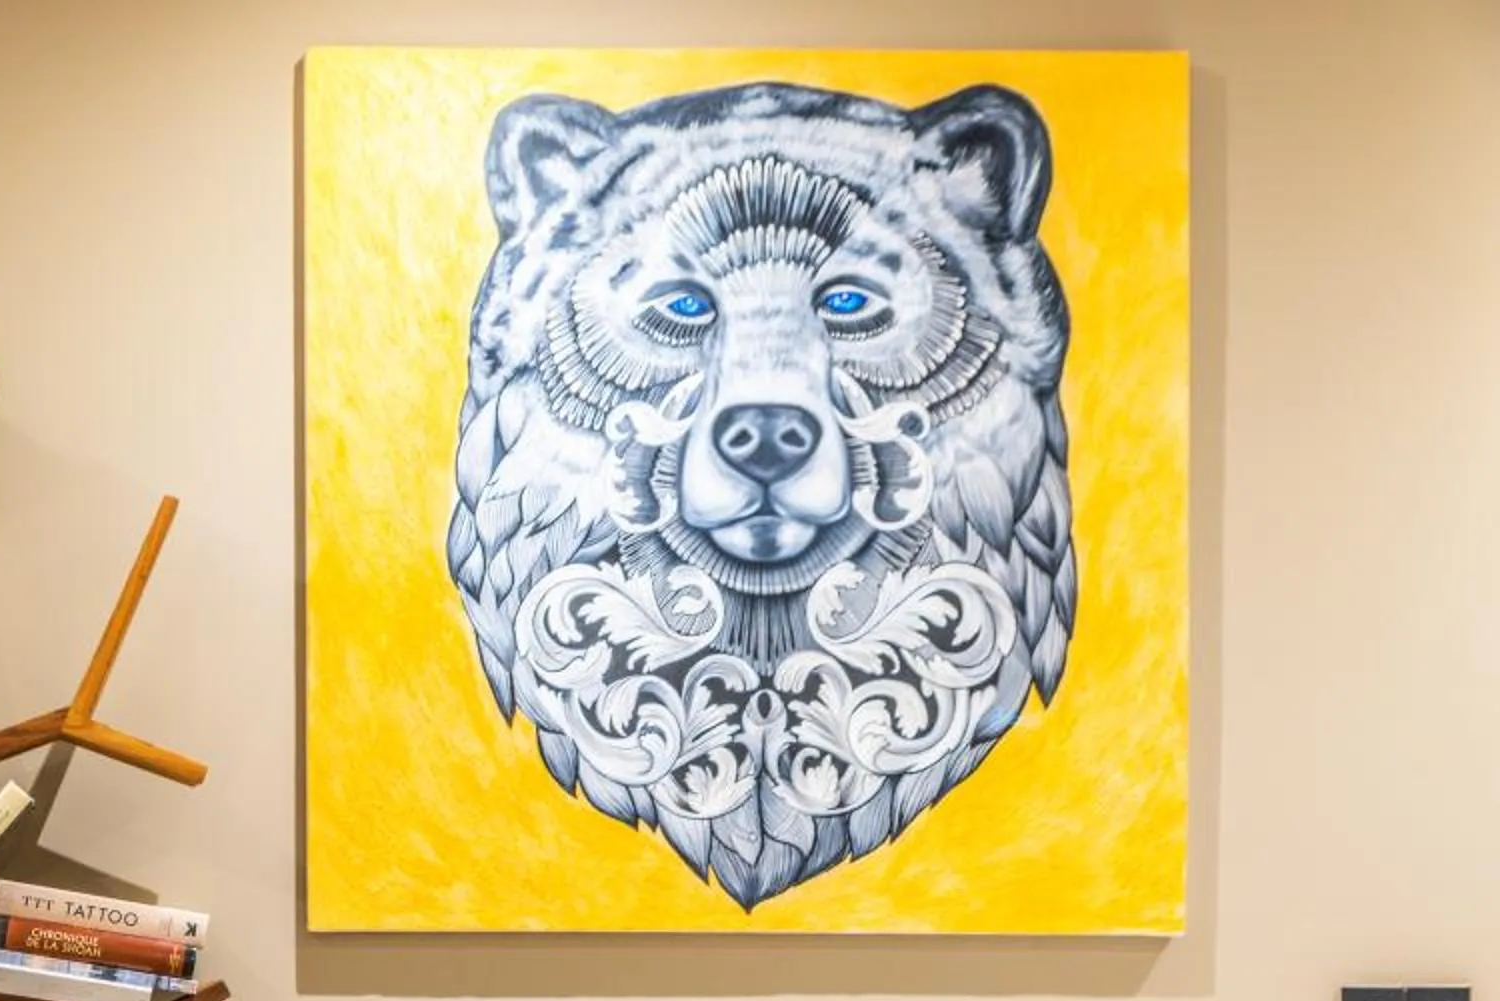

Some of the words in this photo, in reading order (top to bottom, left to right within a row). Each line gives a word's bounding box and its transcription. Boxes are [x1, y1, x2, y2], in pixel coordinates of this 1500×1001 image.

[21, 894, 55, 911] TTT
[63, 901, 140, 928] TATTOO
[25, 936, 41, 948] DE
[43, 939, 58, 951] LA
[61, 942, 101, 958] SHOAH
[30, 926, 100, 949] CHRONIQUE
